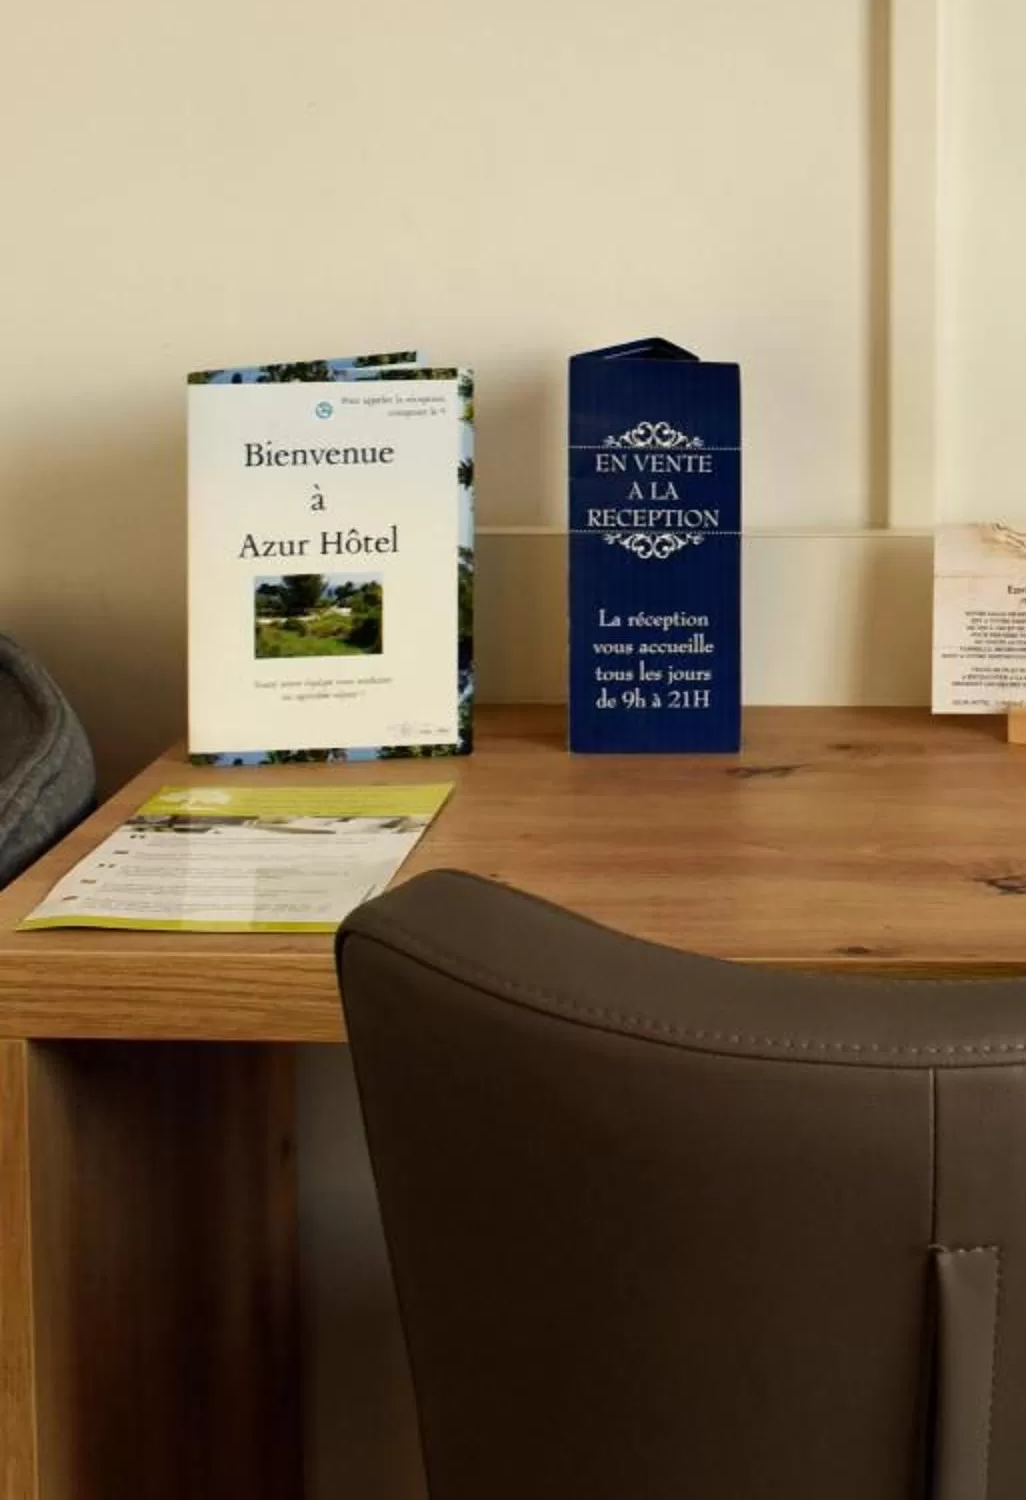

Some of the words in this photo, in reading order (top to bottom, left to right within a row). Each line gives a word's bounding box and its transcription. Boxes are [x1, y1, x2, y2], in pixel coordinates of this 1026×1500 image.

[244, 440, 395, 468] Bienvenue
[596, 453, 627, 473] EN
[634, 453, 713, 474] VENTE
[311, 484, 327, 512] à
[628, 481, 644, 500] A
[650, 482, 679, 501] LA
[587, 508, 720, 528] RECEPTION
[239, 533, 310, 559] Azur
[321, 525, 400, 557] Hôtel
[599, 609, 621, 627] La
[627, 612, 709, 630] réception
[593, 641, 634, 656] vous
[639, 634, 715, 655] accueille
[595, 665, 634, 682] tous
[639, 660, 662, 682] les
[667, 665, 712, 685] jours
[596, 688, 617, 709] de
[621, 690, 646, 709] 9h
[651, 691, 662, 709] à
[667, 689, 711, 709] 21H
